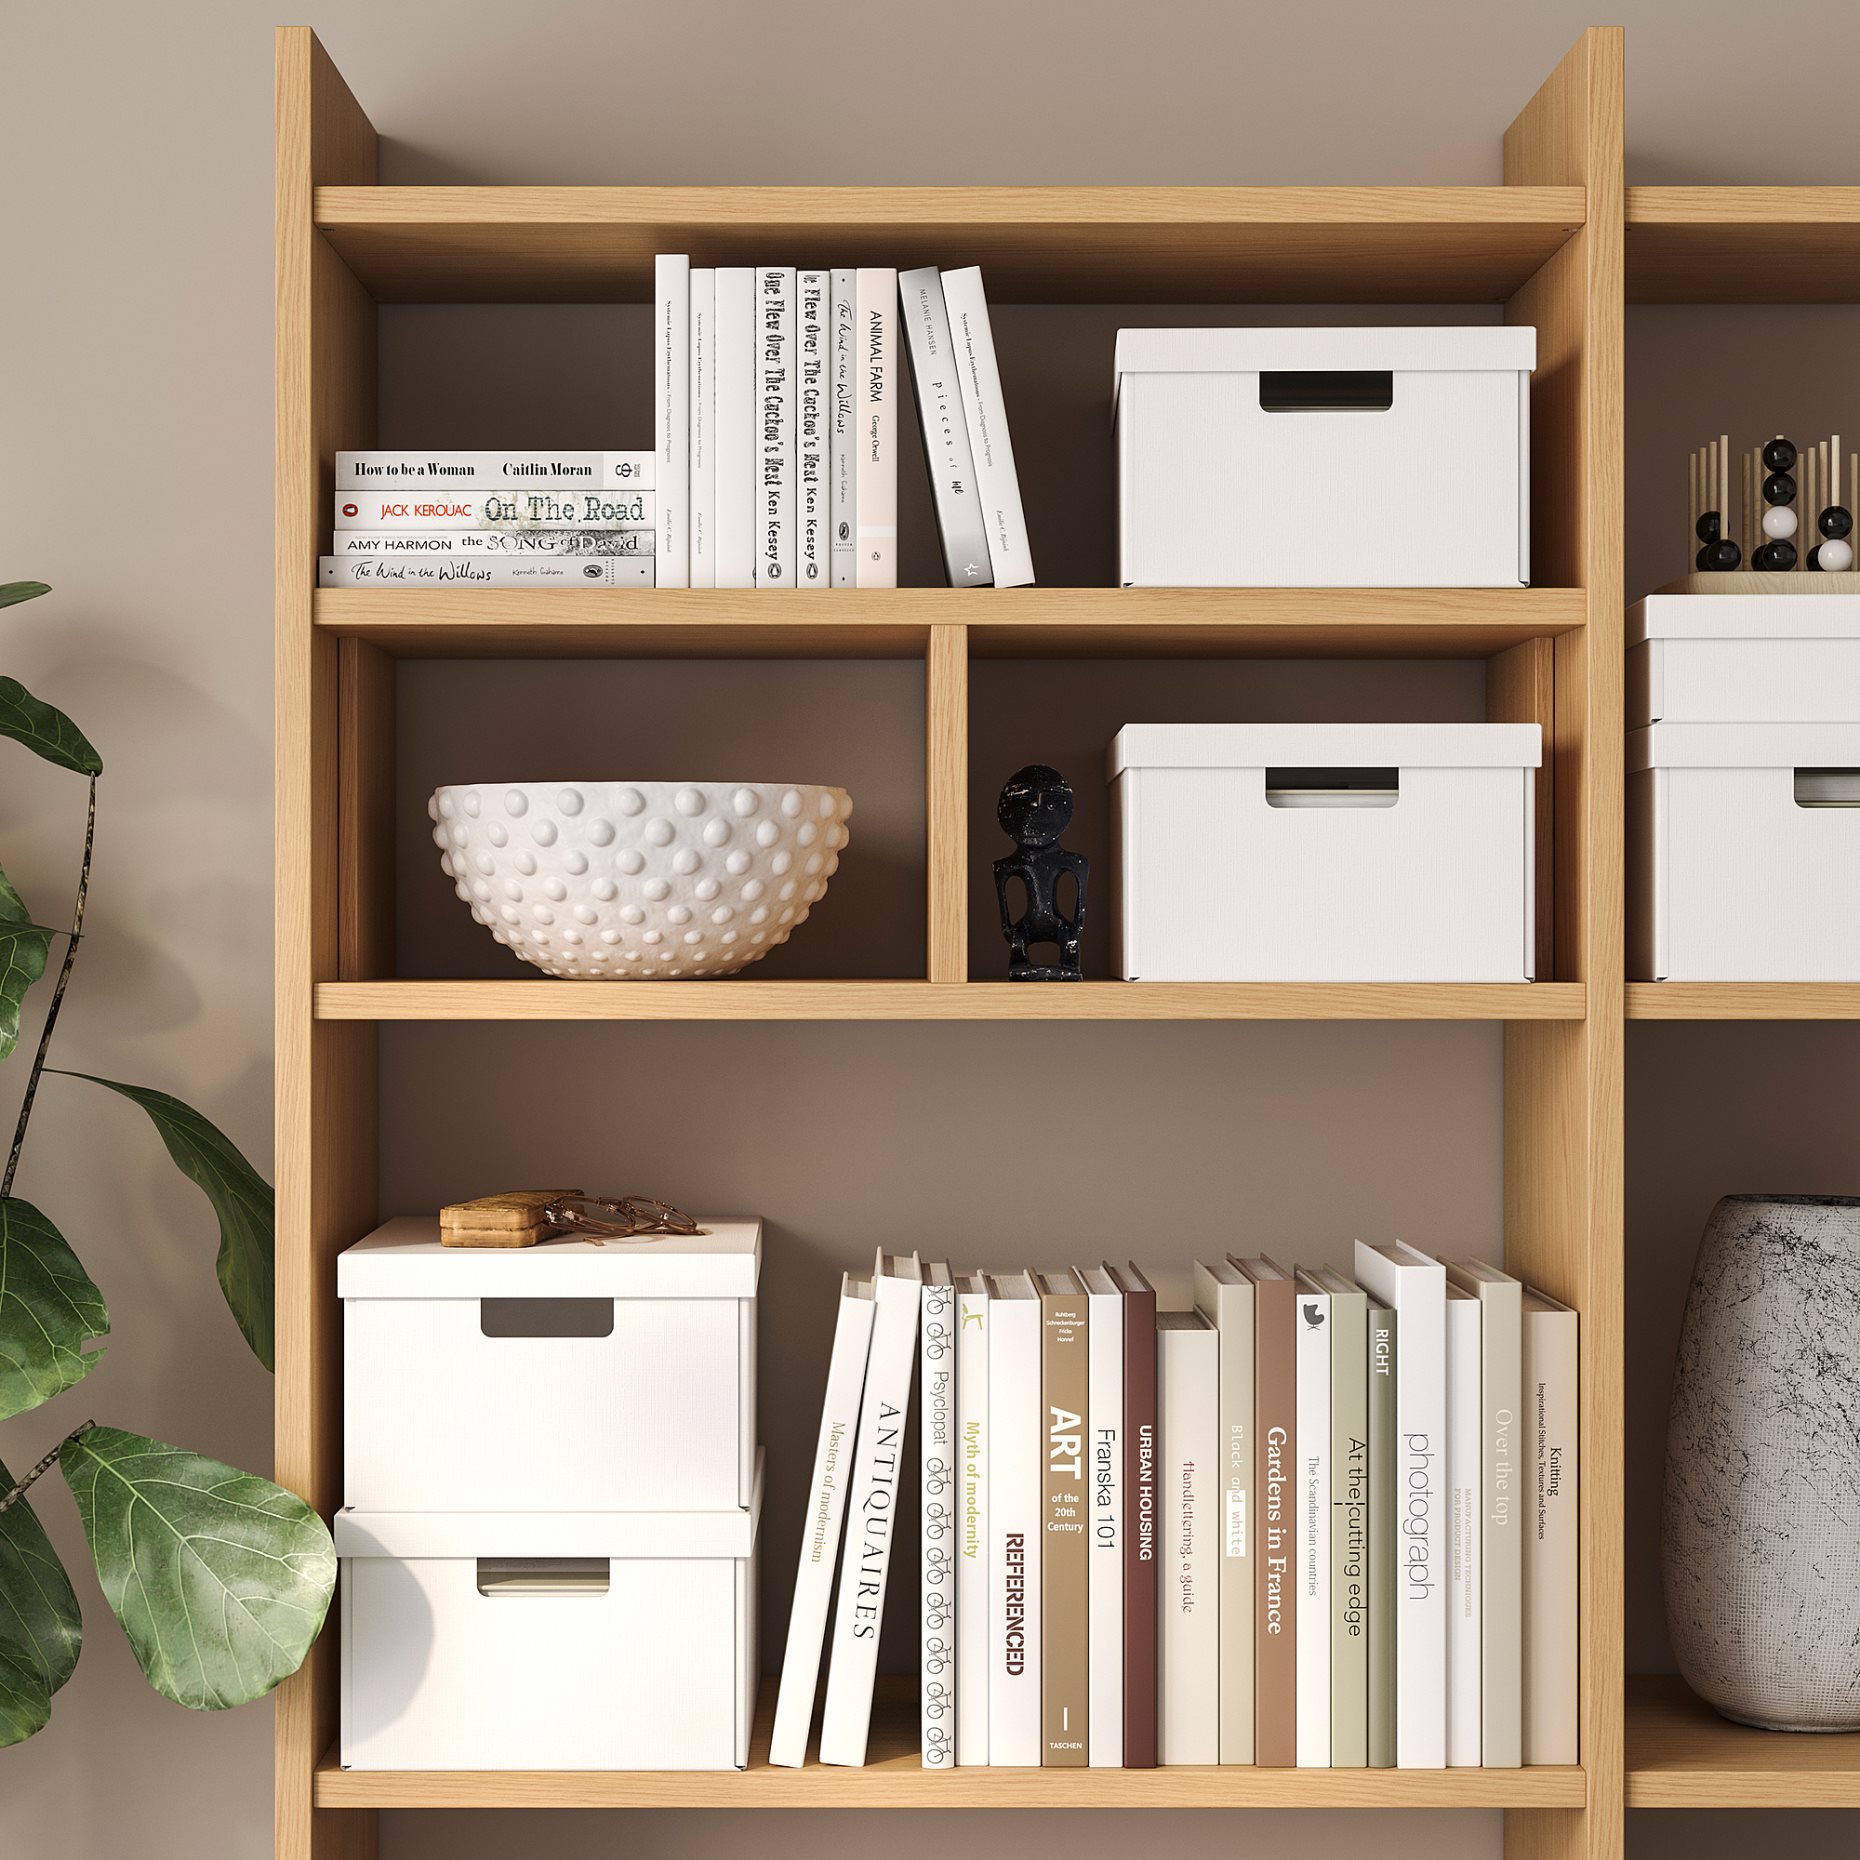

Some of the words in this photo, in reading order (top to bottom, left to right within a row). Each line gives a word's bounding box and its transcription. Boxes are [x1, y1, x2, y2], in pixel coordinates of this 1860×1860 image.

[764, 273, 785, 295] One
[765, 300, 785, 330] Flew
[804, 289, 820, 321] Flew
[837, 300, 853, 320] The
[920, 288, 933, 321] MELANIE
[765, 335, 785, 365] Over
[804, 324, 820, 356] Over
[837, 324, 852, 352] Wind
[870, 310, 882, 363] ANIMAL
[926, 324, 937, 356] HANSEN
[804, 360, 820, 384] The
[840, 354, 847, 363] in
[840, 366, 848, 380] the
[764, 368, 785, 392] The
[870, 366, 882, 403] FARM
[764, 396, 784, 453] Cuckoo's
[803, 389, 820, 448] Cuckoo's
[836, 384, 853, 434] Willows
[932, 381, 954, 446] pieces
[870, 415, 880, 438] George
[871, 440, 880, 462] Orwell
[355, 463, 384, 476] How
[387, 464, 399, 476] to
[401, 463, 415, 476] be
[417, 466, 425, 476] a
[427, 463, 475, 476] Woman
[502, 462, 548, 476] Caitlin
[551, 462, 593, 476] Moran
[764, 458, 784, 487] Nest
[804, 453, 820, 483] Nest
[381, 504, 409, 520] JACK
[414, 504, 472, 517] KEROUAC
[485, 497, 518, 522] On
[583, 497, 645, 521] Road
[768, 491, 781, 515] Ken
[807, 488, 818, 513] Ken
[347, 540, 381, 550] AMY
[385, 540, 452, 550] HARMON
[461, 536, 483, 546] the
[487, 535, 557, 550] SONG
[560, 536, 575, 547] of
[580, 536, 639, 550] David
[766, 520, 781, 560] Kesey
[804, 519, 818, 560] Kesey
[351, 561, 373, 580] The
[376, 562, 406, 580] Wind
[408, 567, 417, 576] in
[418, 567, 435, 577] the
[439, 561, 492, 581] Willows
[1376, 1329, 1389, 1376] RIGHT
[929, 1371, 949, 1445] Psyclopat
[1536, 1383, 1546, 1429] Inspirational
[825, 1422, 846, 1473] Masters
[964, 1421, 980, 1459] Myth
[1050, 1405, 1081, 1480] ART
[1231, 1424, 1243, 1468] Black
[1495, 1409, 1513, 1456] Over
[1139, 1425, 1152, 1482] URBAN
[1349, 1437, 1366, 1461] At
[966, 1464, 980, 1479] of
[1097, 1429, 1115, 1507] Franska
[1268, 1426, 1287, 1521] Gardens
[1308, 1456, 1320, 1476] The
[1495, 1462, 1513, 1490] the
[1538, 1461, 1546, 1493] Textures
[1547, 1447, 1562, 1497] Knitting
[823, 1475, 836, 1491] of
[1051, 1493, 1062, 1503] of
[1063, 1493, 1080, 1503] the
[1231, 1477, 1243, 1503] and
[1349, 1467, 1368, 1499] the
[1055, 1507, 1076, 1517] 20th
[1180, 1461, 1195, 1559] Handlettering,
[1308, 1479, 1320, 1546] Scandinavian
[1403, 1433, 1435, 1600] photograph
[1491, 1496, 1511, 1526] top
[1538, 1494, 1546, 1508] and
[811, 1492, 831, 1563] modernism
[853, 1402, 902, 1639] ANTIQUAIRES
[963, 1482, 980, 1559] modernity
[1047, 1522, 1084, 1533] Century
[1097, 1515, 1115, 1548] 101
[1139, 1486, 1152, 1561] HOUSING
[1231, 1511, 1243, 1556] white
[1538, 1509, 1546, 1540] Surfaces
[1268, 1527, 1287, 1550] in
[1344, 1507, 1366, 1577] cutting
[1183, 1563, 1192, 1571] a
[1308, 1548, 1319, 1596] countries
[1006, 1533, 1024, 1676] REFERENCED
[1180, 1575, 1195, 1613] guide
[1268, 1556, 1287, 1635] France
[1344, 1584, 1368, 1637] edge
